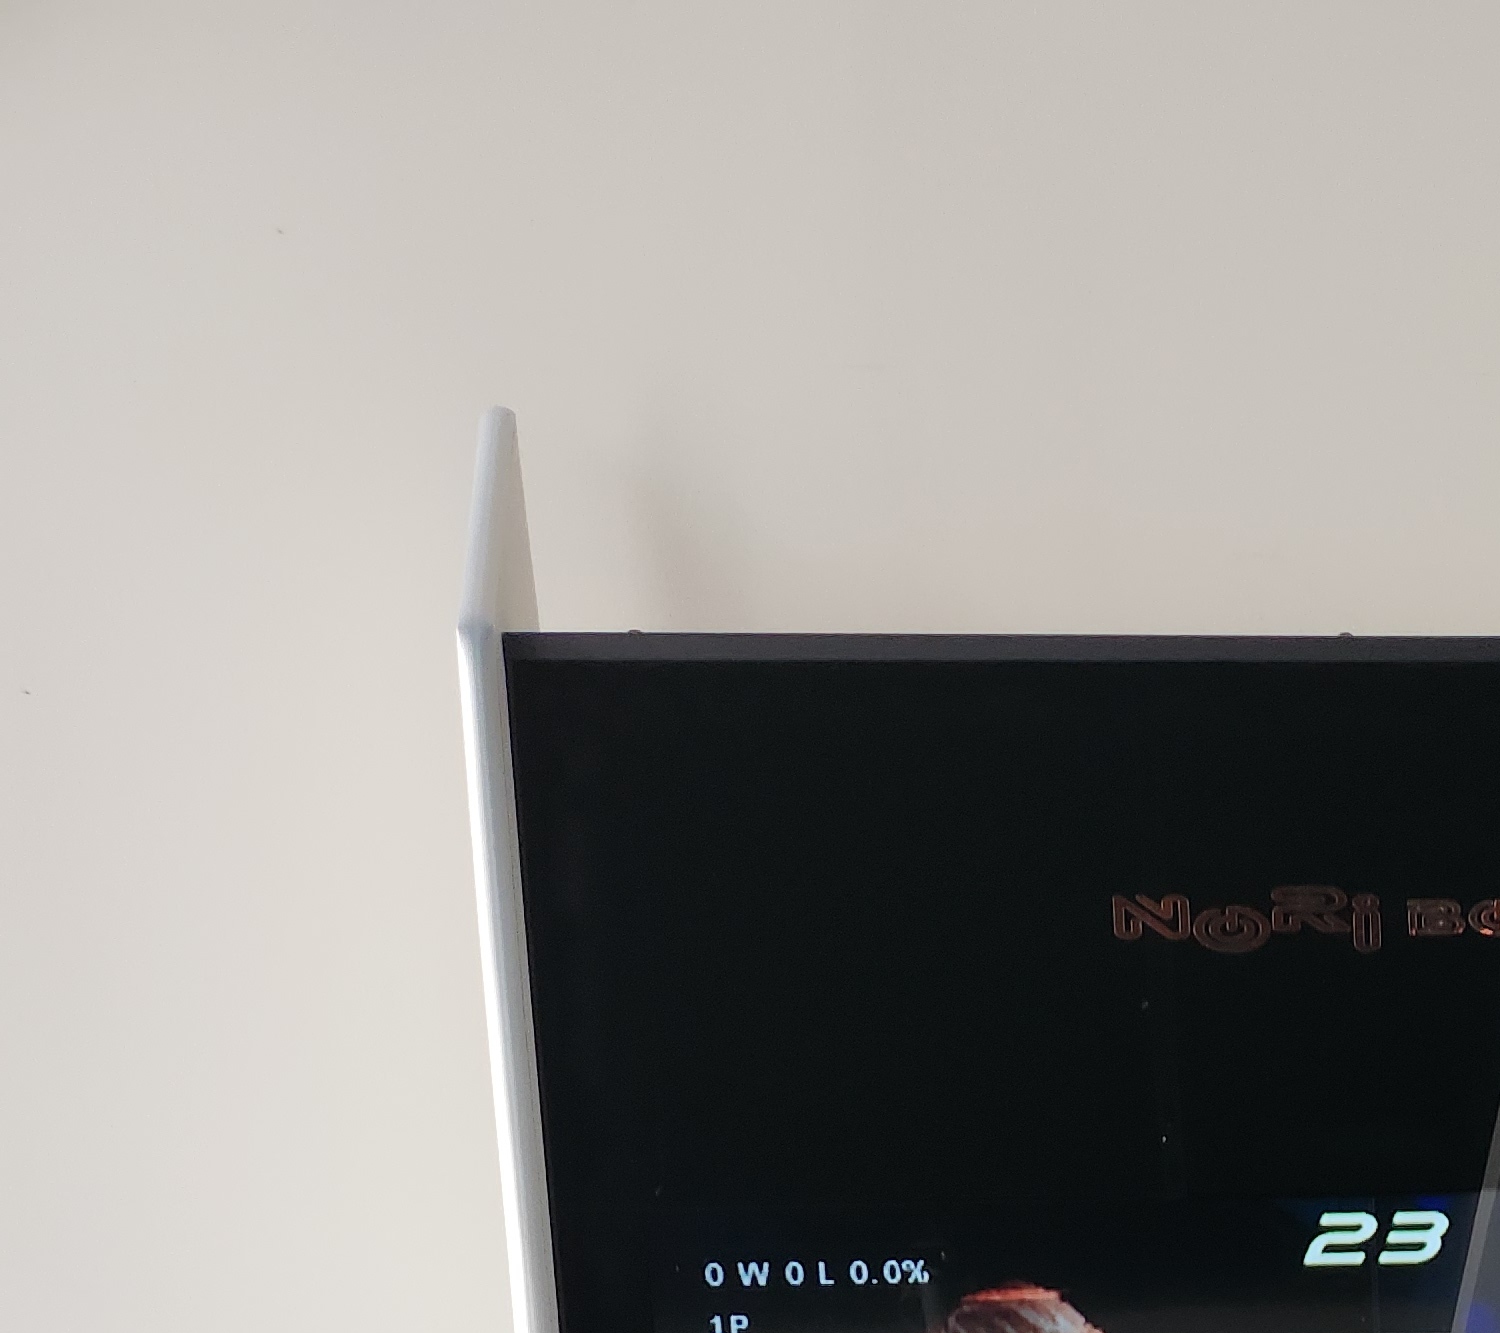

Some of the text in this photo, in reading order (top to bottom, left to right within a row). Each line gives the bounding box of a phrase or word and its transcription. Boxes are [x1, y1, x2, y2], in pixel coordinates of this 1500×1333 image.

[1302, 1210, 1450, 1267] 23
[704, 1258, 930, 1287] 0 W 0 L 0.0%
